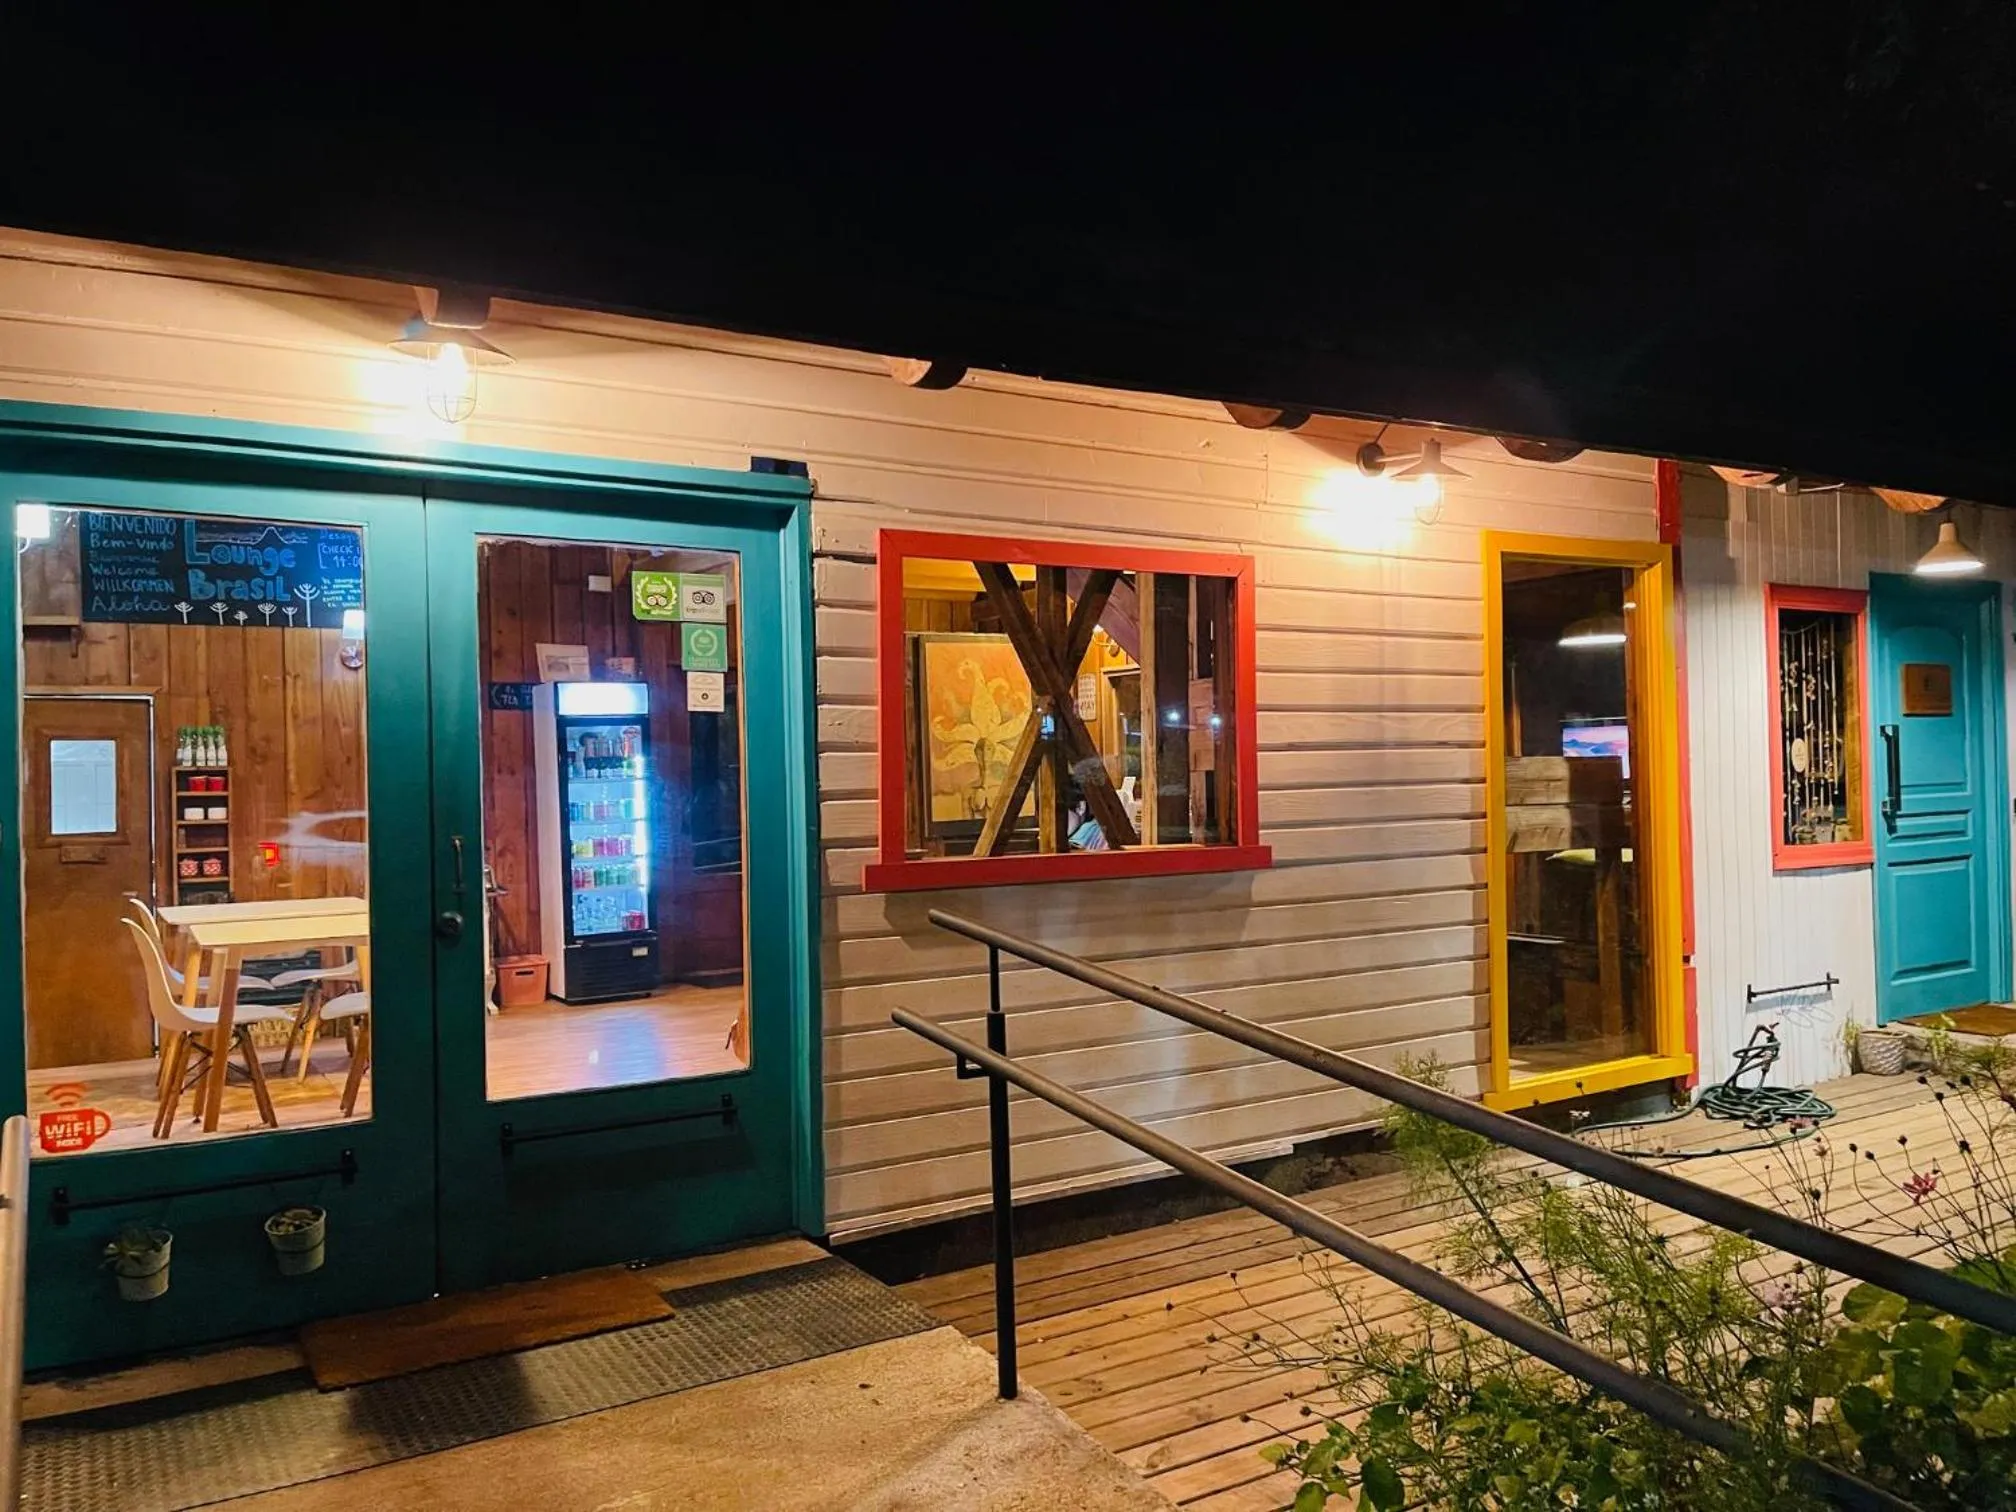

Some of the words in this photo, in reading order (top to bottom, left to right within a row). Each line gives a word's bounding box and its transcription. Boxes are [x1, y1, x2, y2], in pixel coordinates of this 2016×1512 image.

[88, 512, 177, 536] BIENVENIDO
[184, 518, 296, 576] Lounge
[89, 563, 159, 576] Welcome
